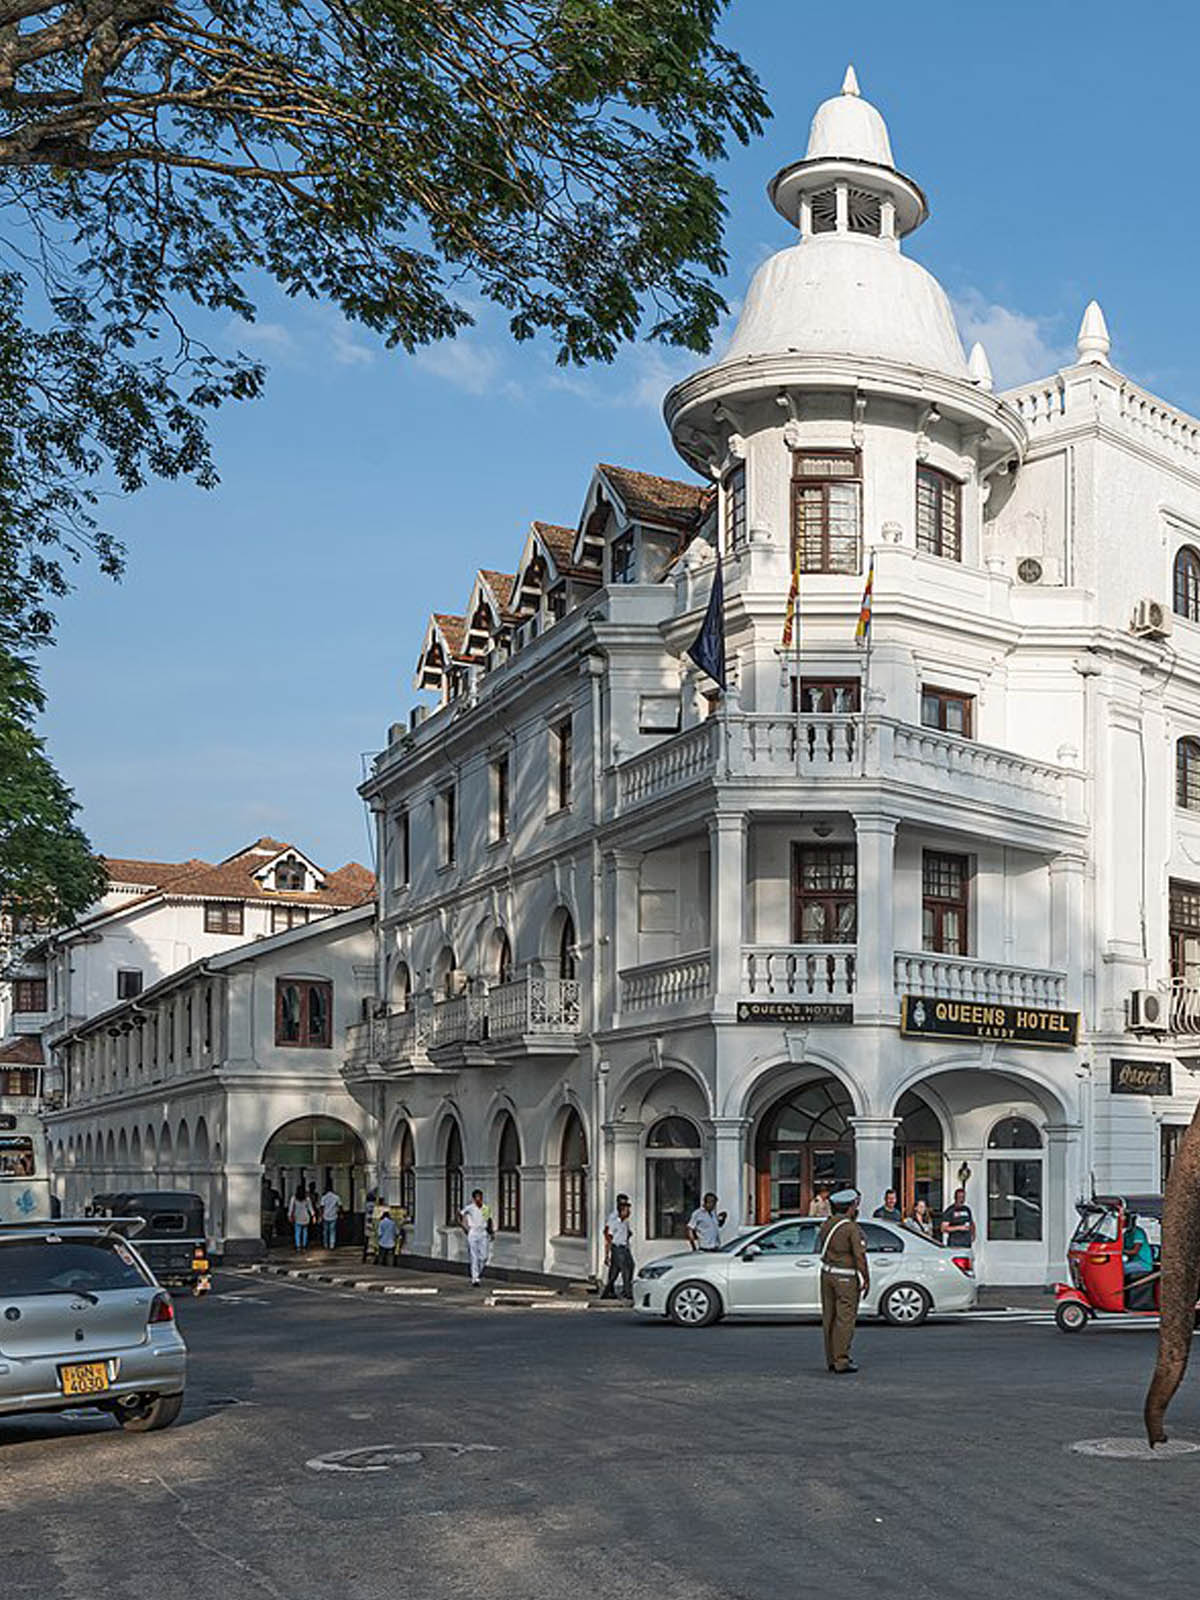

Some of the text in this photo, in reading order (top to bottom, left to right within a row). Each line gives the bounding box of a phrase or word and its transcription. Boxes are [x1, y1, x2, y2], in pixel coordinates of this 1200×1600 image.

[805, 1005, 846, 1015] HOTEL
[1017, 1011, 1070, 1032] HOTEL
[977, 1026, 1015, 1038] KANDY
